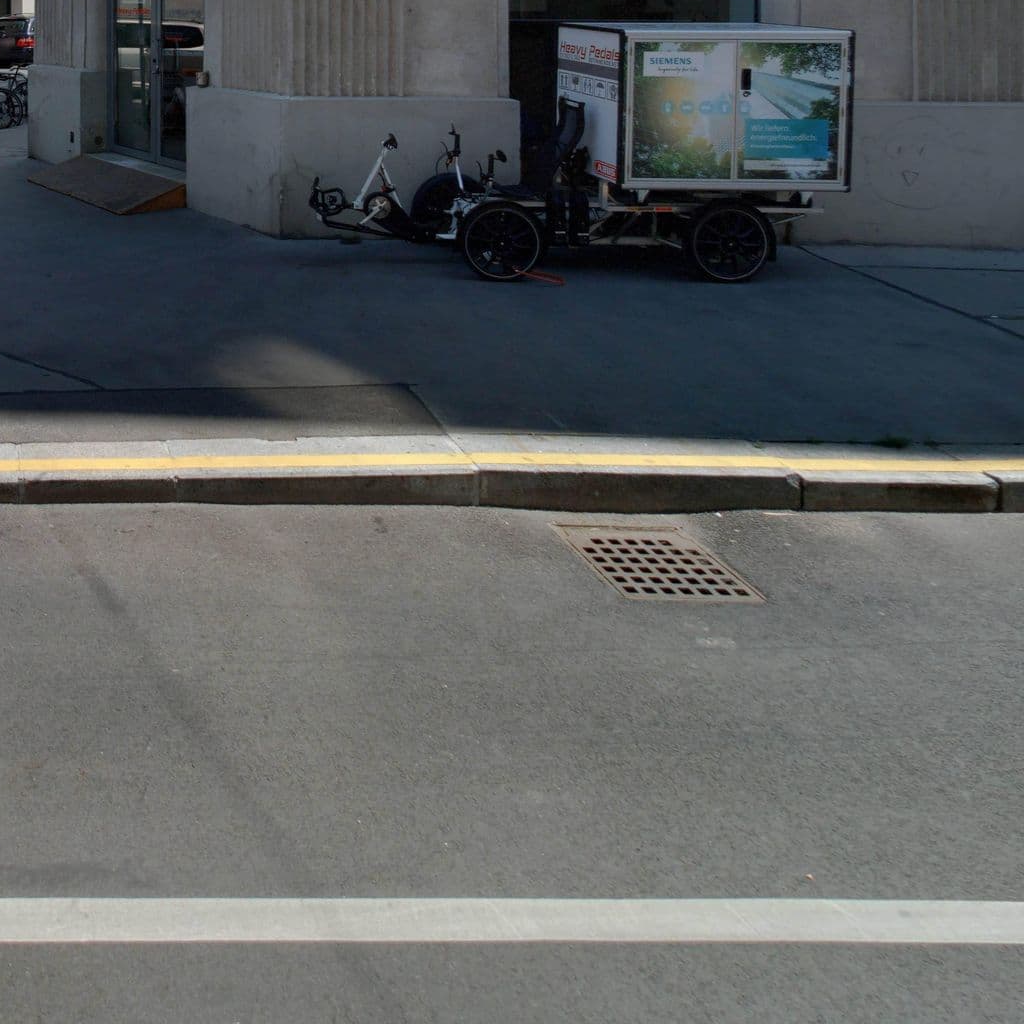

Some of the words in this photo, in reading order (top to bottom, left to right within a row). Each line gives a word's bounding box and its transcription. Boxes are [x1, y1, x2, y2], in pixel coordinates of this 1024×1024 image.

[560, 40, 587, 60] Heavy
[588, 44, 621, 62] Pedals
[649, 57, 692, 65] SIEMENS
